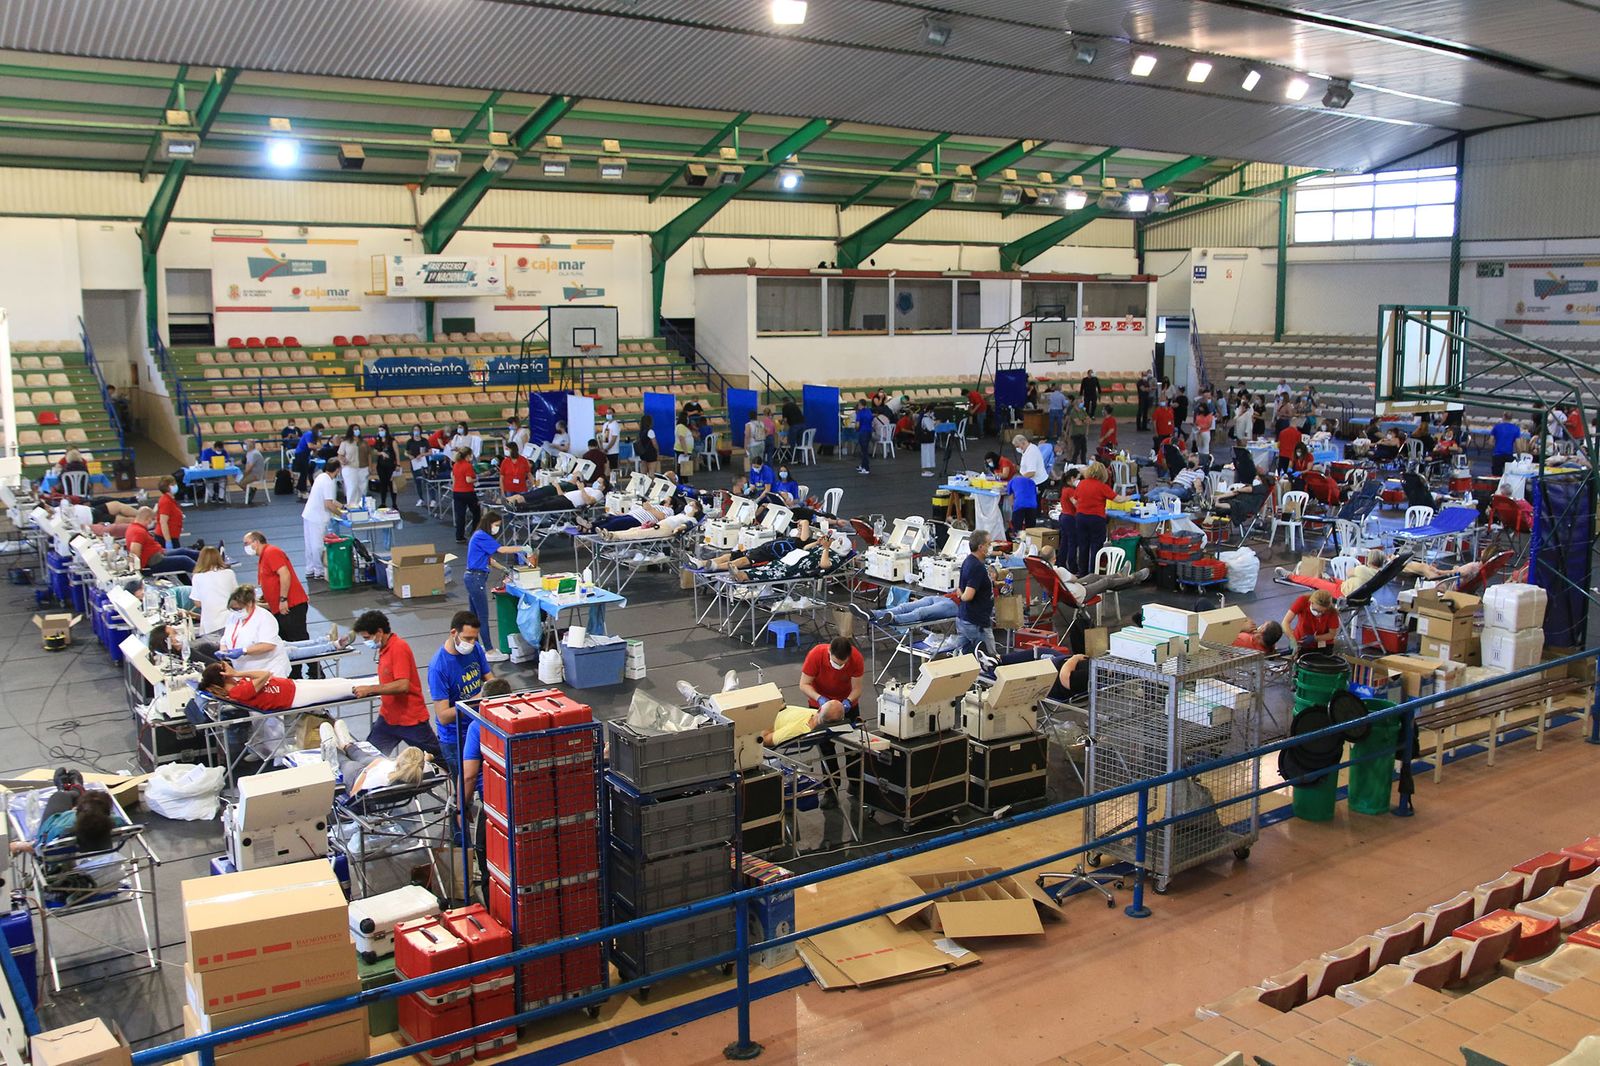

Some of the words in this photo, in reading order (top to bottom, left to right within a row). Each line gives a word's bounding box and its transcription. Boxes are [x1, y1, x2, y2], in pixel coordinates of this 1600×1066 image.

[531, 256, 585, 274] cajamar
[435, 272, 468, 282] NACIONAL
[303, 286, 350, 299] cajamar
[369, 362, 464, 379] Ayuntamiento
[497, 360, 544, 374] Almería
